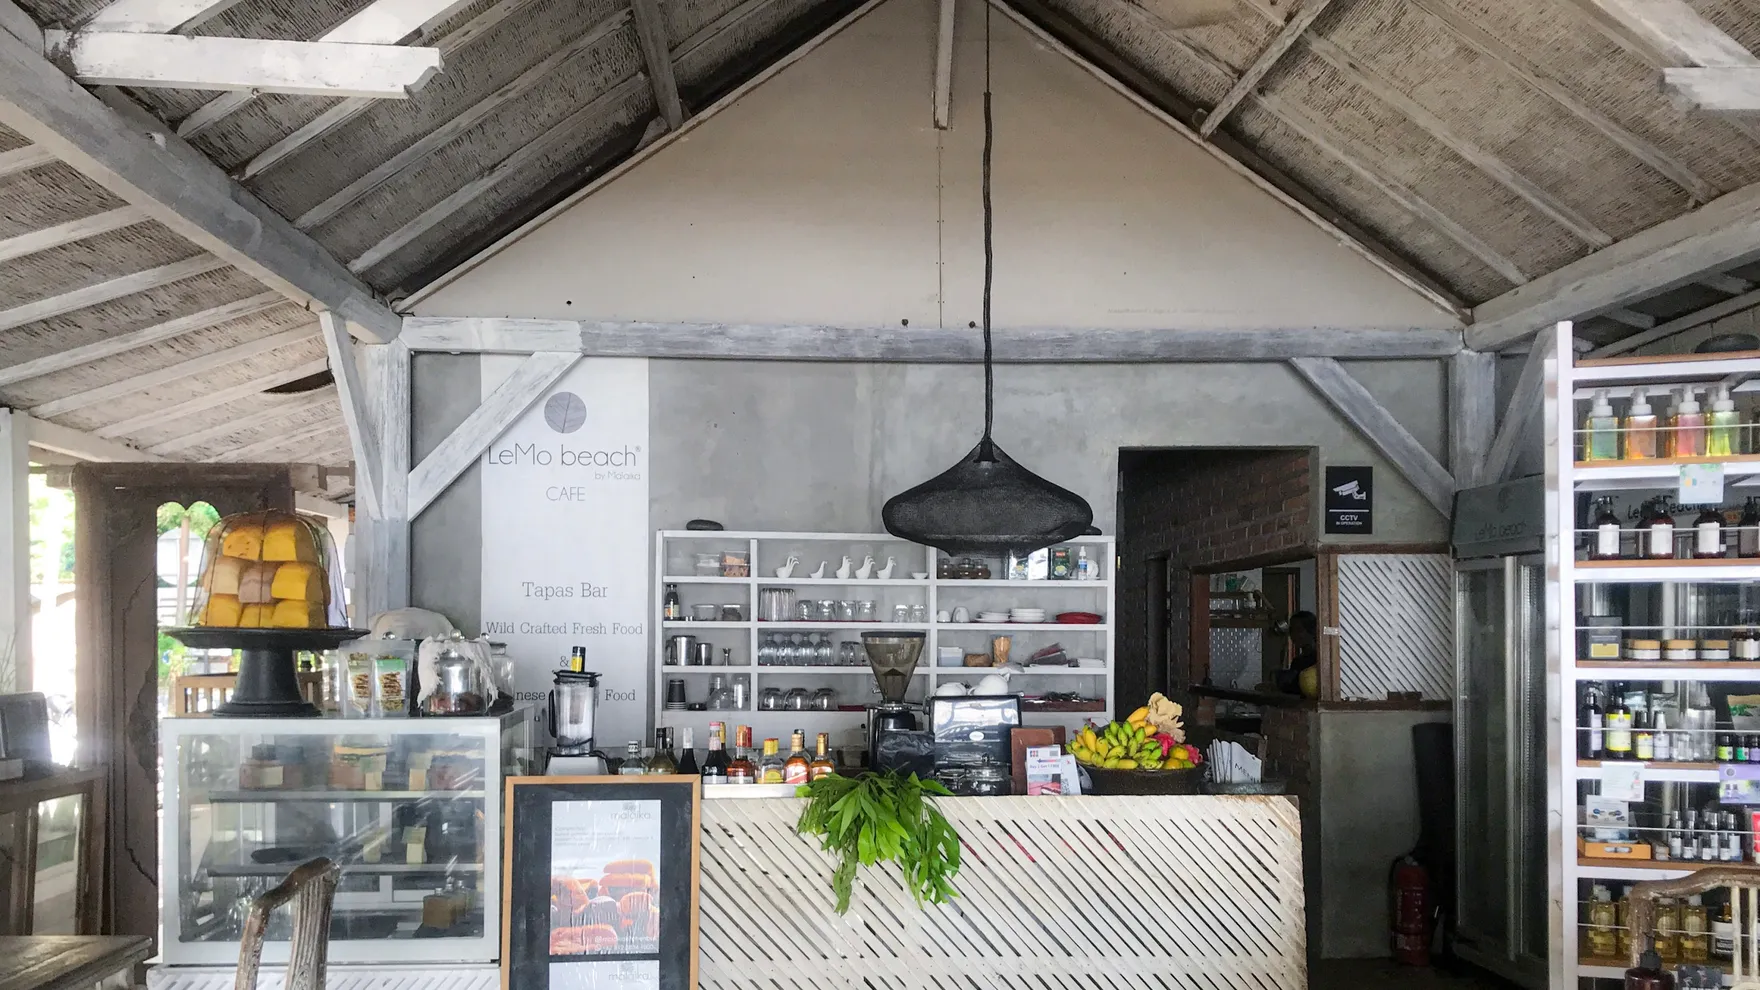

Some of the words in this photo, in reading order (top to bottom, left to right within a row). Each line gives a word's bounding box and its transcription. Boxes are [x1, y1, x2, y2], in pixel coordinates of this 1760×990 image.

[488, 443, 552, 465] LeMo
[594, 471, 605, 480] by
[545, 486, 586, 501] CAFE
[522, 581, 574, 600] Tapas
[581, 581, 608, 598] Bar
[486, 622, 515, 634] Wild
[520, 622, 567, 634] Crafted
[572, 622, 607, 634] Fresh
[612, 622, 643, 634] Food
[560, 655, 570, 668] &
[605, 689, 636, 701] Food
